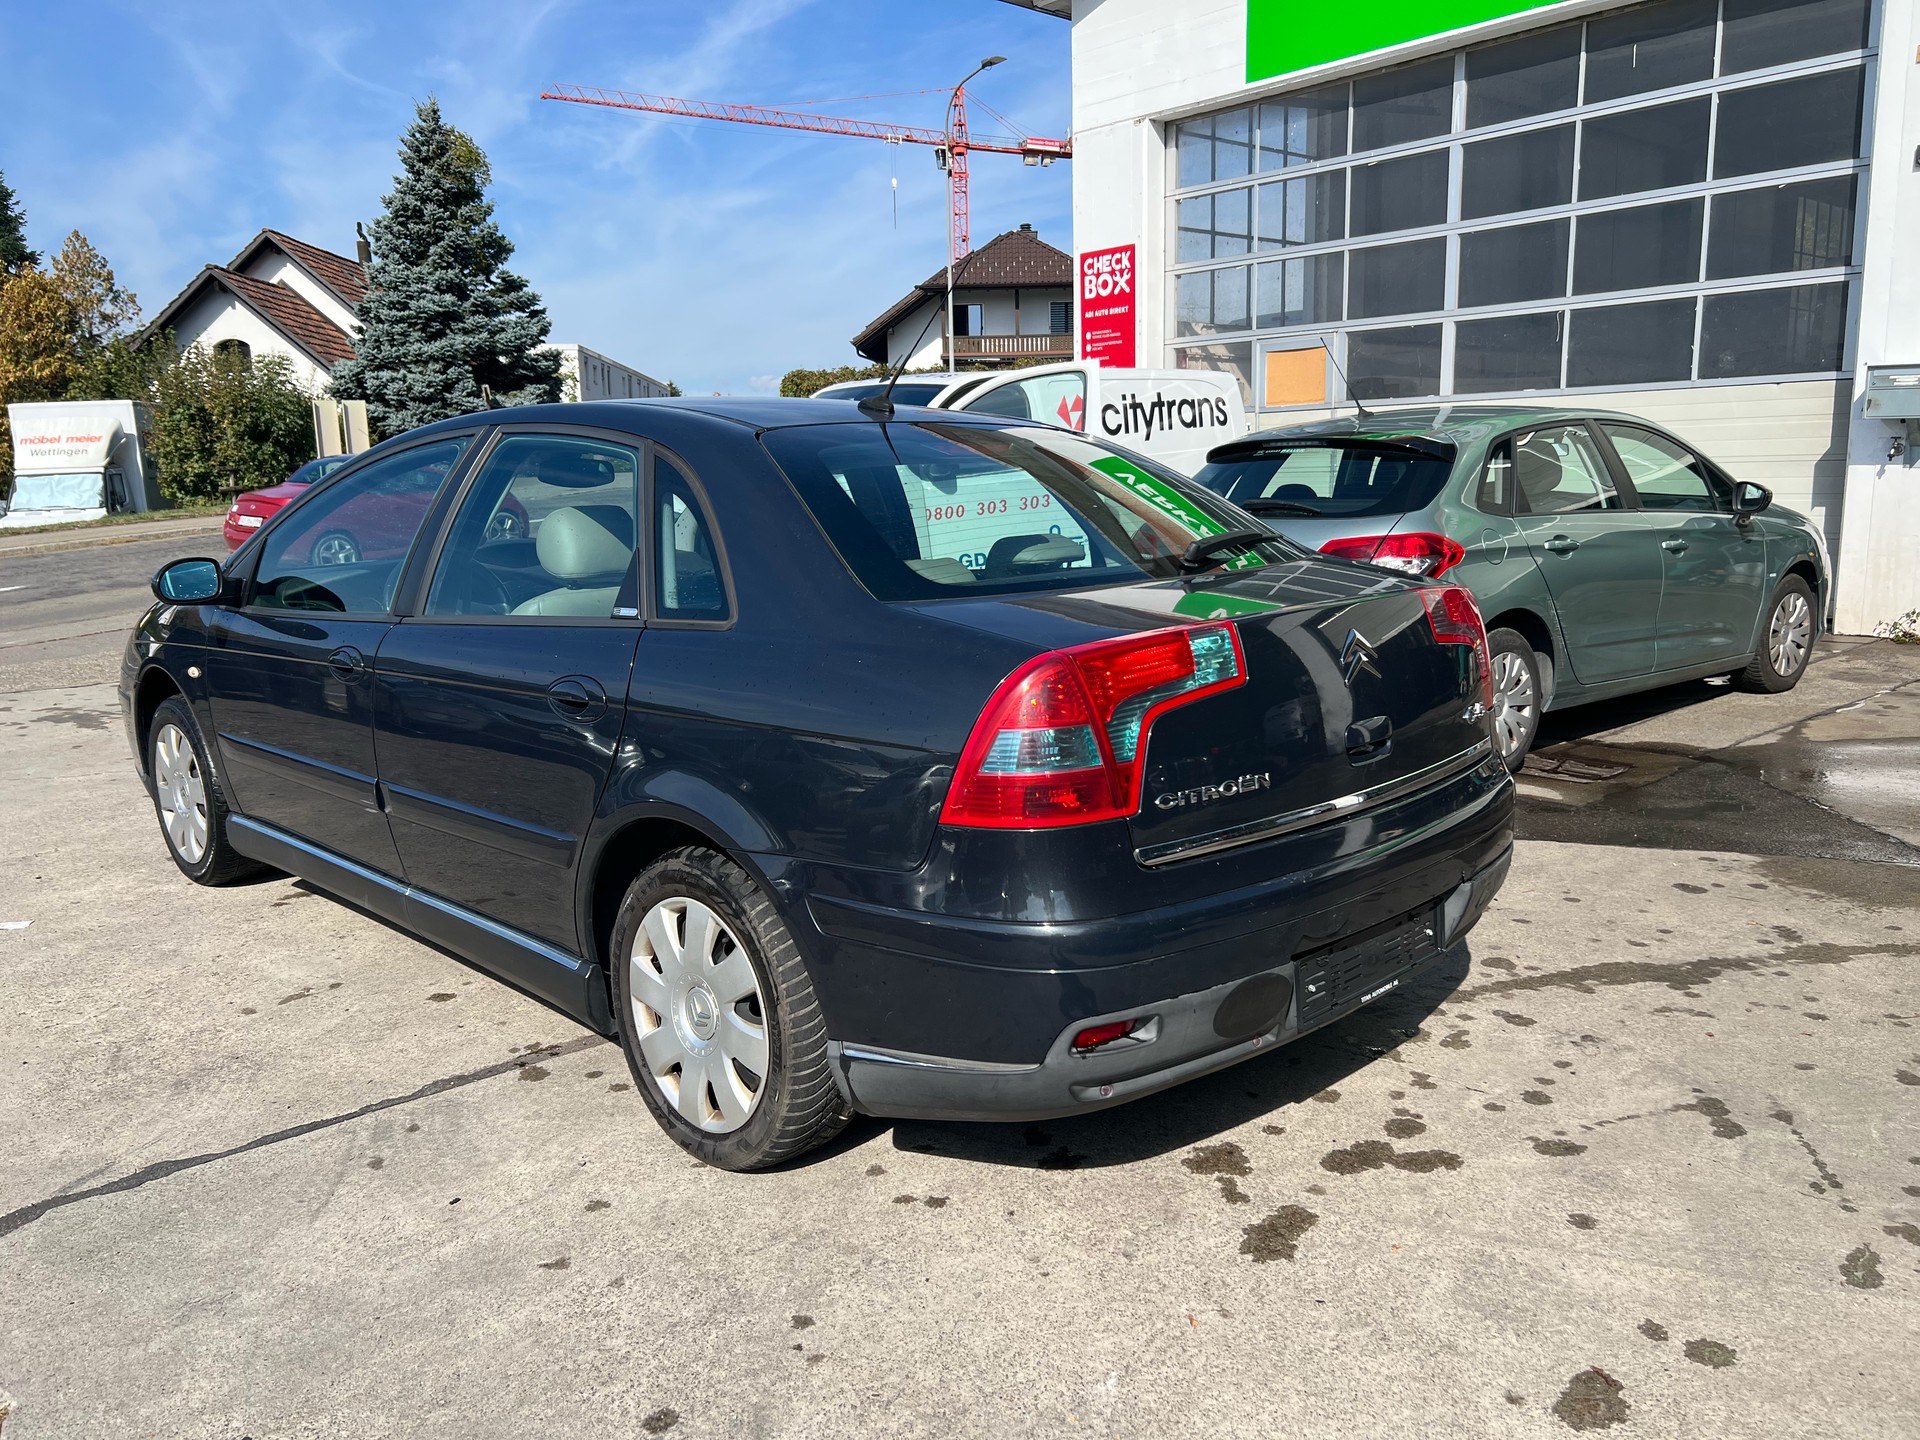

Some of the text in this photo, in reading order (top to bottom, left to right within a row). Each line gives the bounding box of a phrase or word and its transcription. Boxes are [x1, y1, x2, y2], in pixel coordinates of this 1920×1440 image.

[1083, 250, 1131, 275] CHECK
[1084, 268, 1131, 299] BOX
[1094, 309, 1109, 318] AUTO
[1109, 305, 1129, 315] DIREKT
[1101, 392, 1228, 441] citytrans
[20, 434, 104, 446] möbel meier
[30, 447, 88, 457] Wettingen
[976, 500, 1008, 516] 303
[1019, 494, 1051, 511] 303
[1154, 773, 1271, 810] CITROËN
